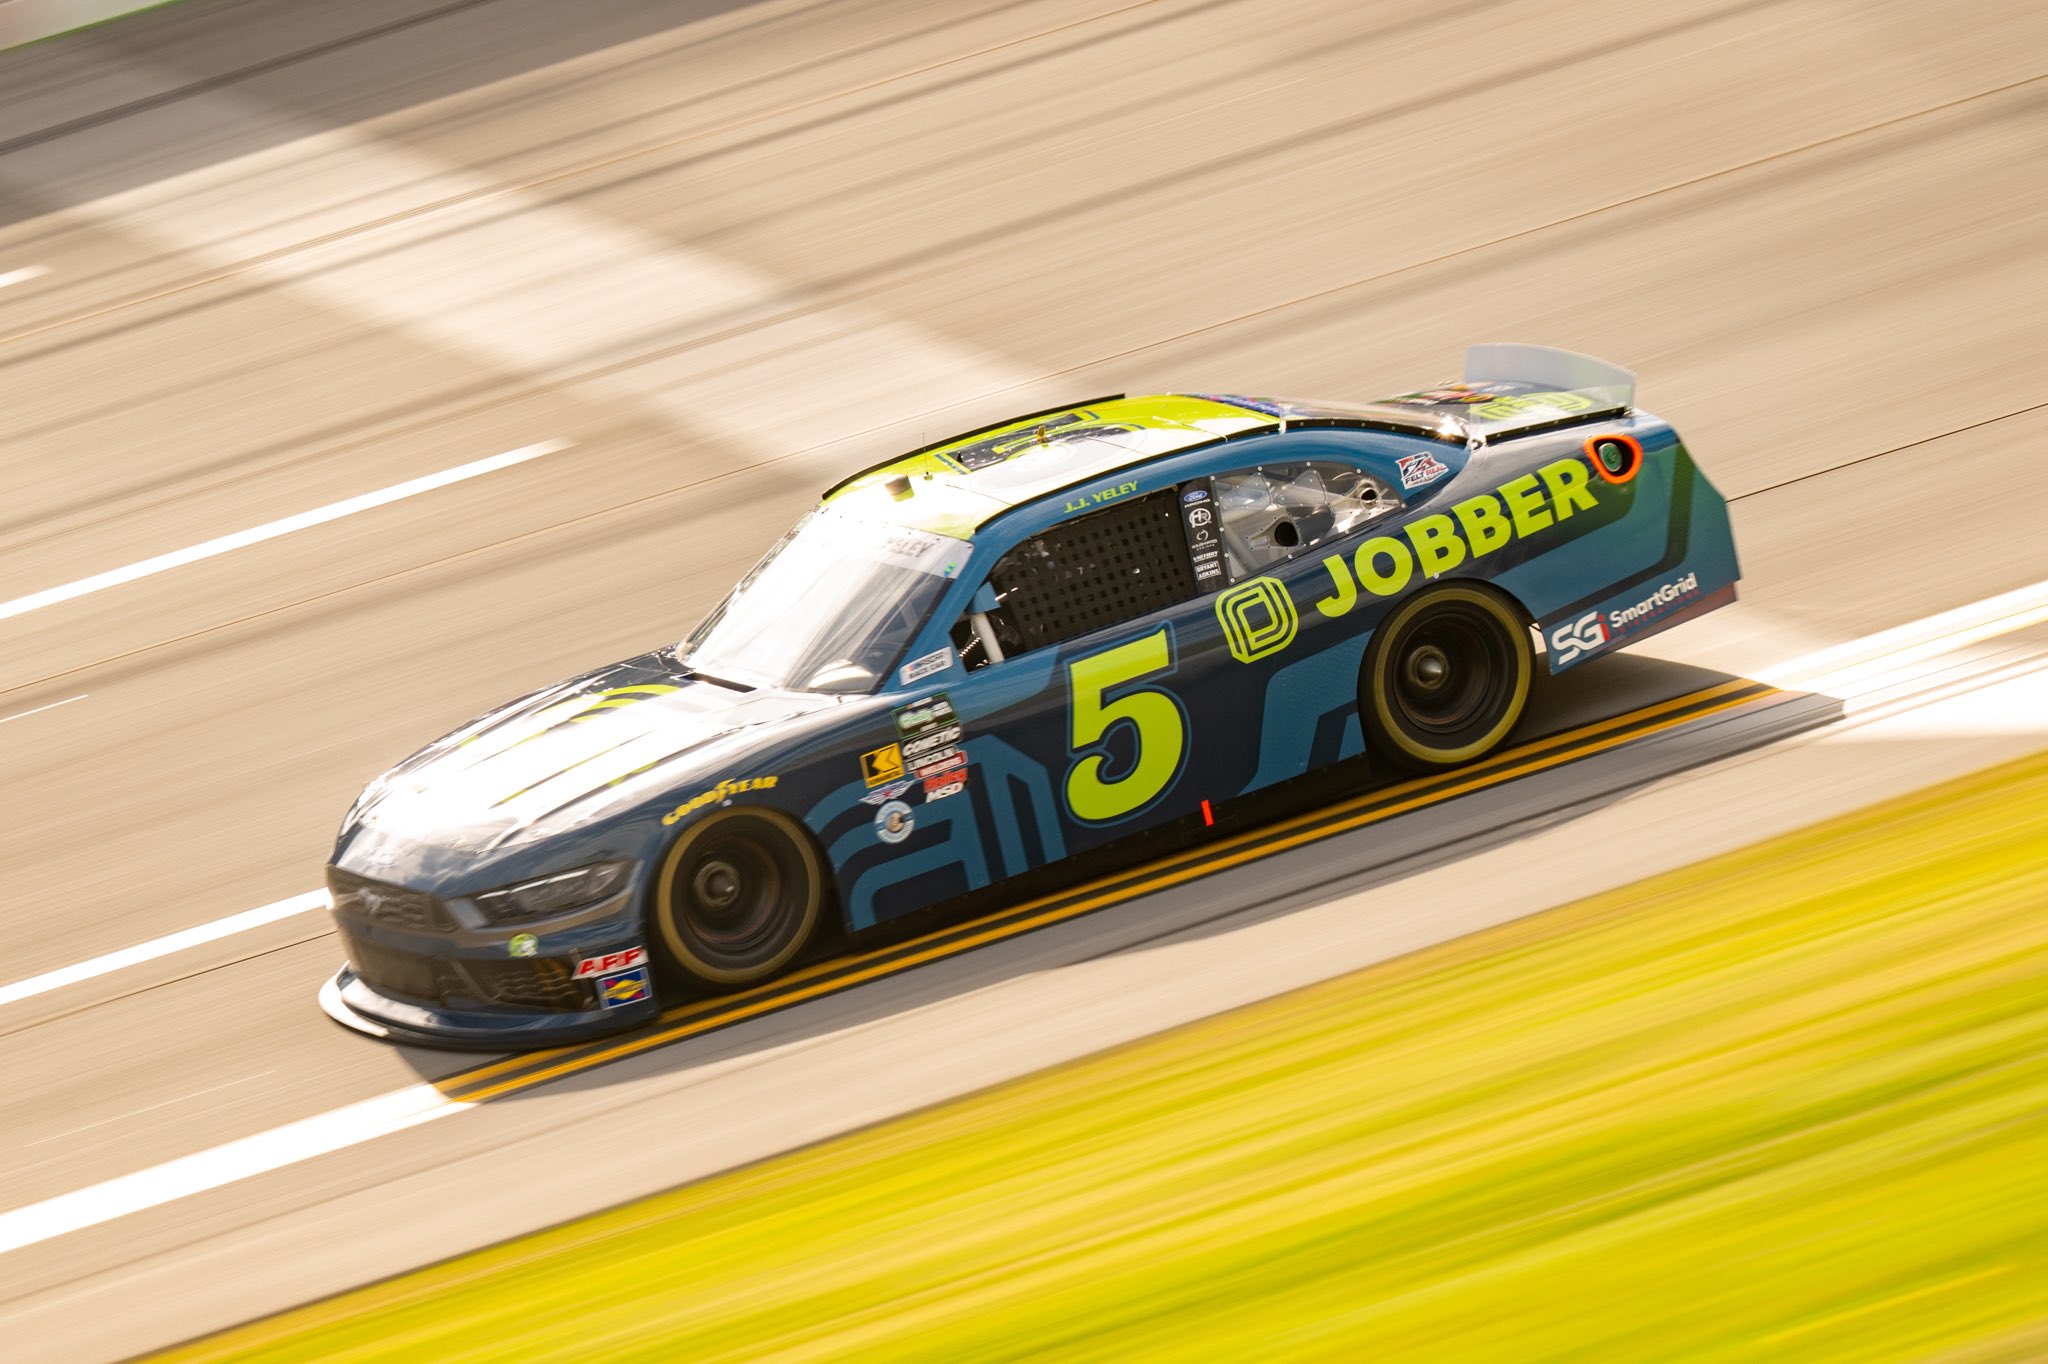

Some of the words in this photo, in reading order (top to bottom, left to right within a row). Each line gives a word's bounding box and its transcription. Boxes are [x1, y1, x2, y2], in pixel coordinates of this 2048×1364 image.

[1063, 498, 1091, 513] J.J.
[1092, 480, 1138, 503] YELEY
[1404, 471, 1424, 485] FELT
[1425, 464, 1447, 476] REAL
[1315, 457, 1599, 618] JOBBER
[1609, 571, 1699, 628] SmartGrid
[1066, 627, 1185, 822] 5
[661, 775, 779, 826] GOODYEAR
